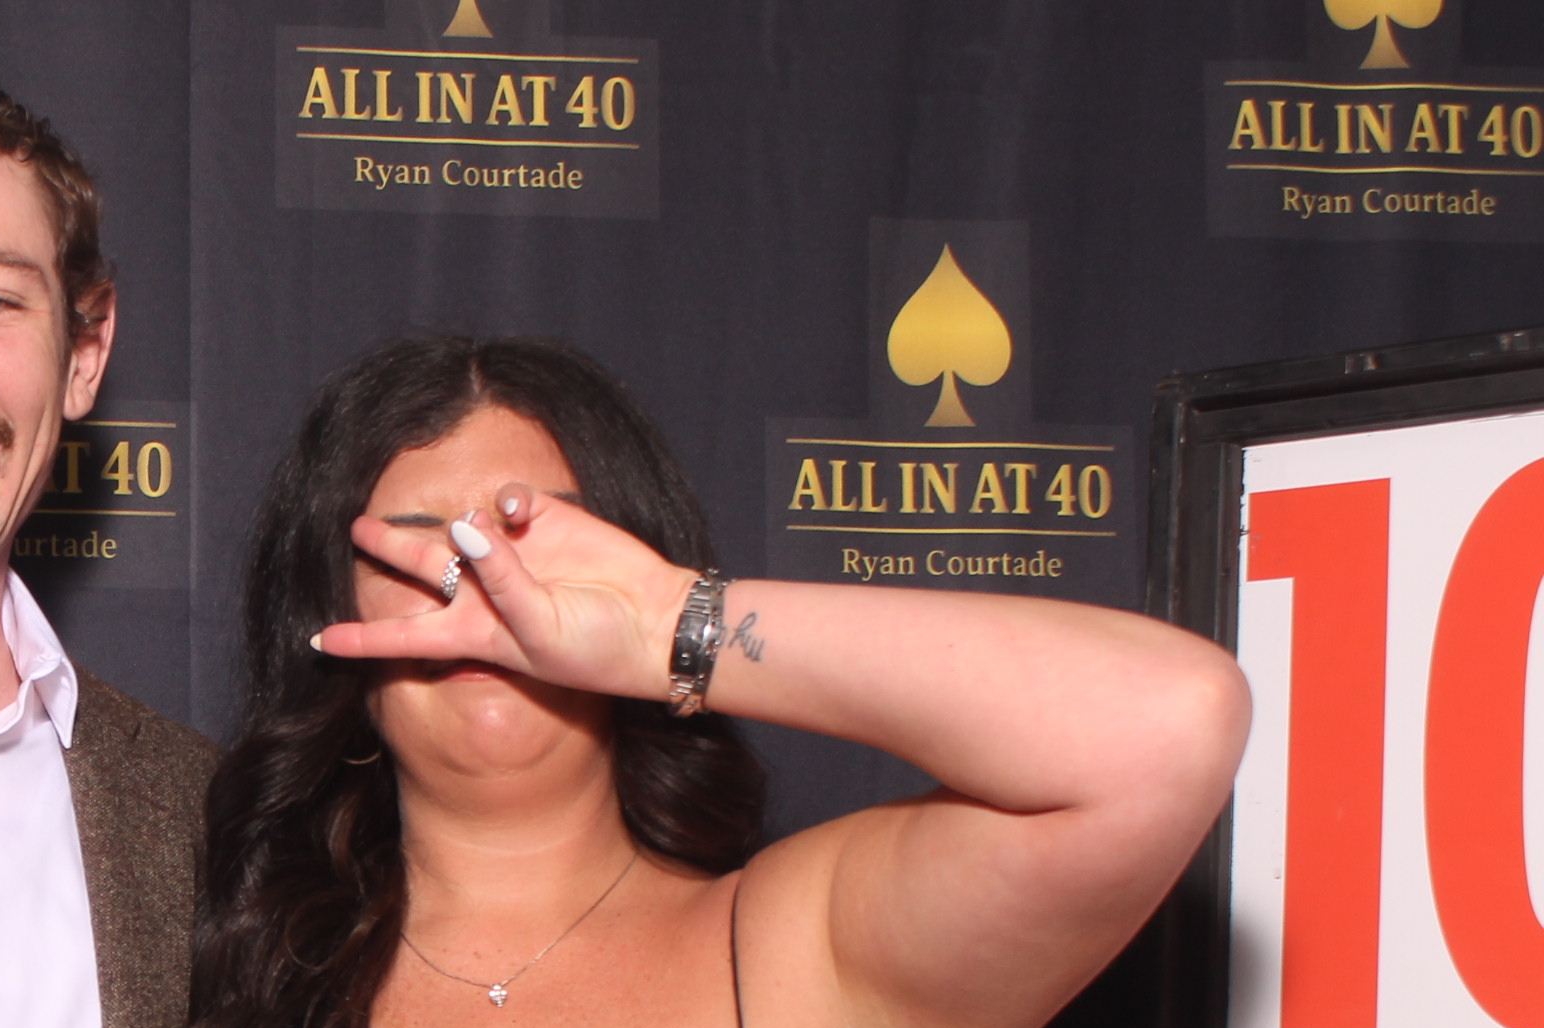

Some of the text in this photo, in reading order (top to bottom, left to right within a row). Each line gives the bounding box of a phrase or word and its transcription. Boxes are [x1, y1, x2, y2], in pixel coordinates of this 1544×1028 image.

[298, 66, 636, 131] ALL IN AT 40
[1227, 99, 1544, 158] ALL IN AT 40
[354, 156, 584, 190] Ryan Courtade
[1281, 186, 1497, 219] Ryan Courtade
[45, 440, 174, 499] T 40
[787, 458, 1113, 519] ALL IN AT 40
[13, 530, 119, 559] urtade
[841, 548, 1064, 582] Ryan Courtade
